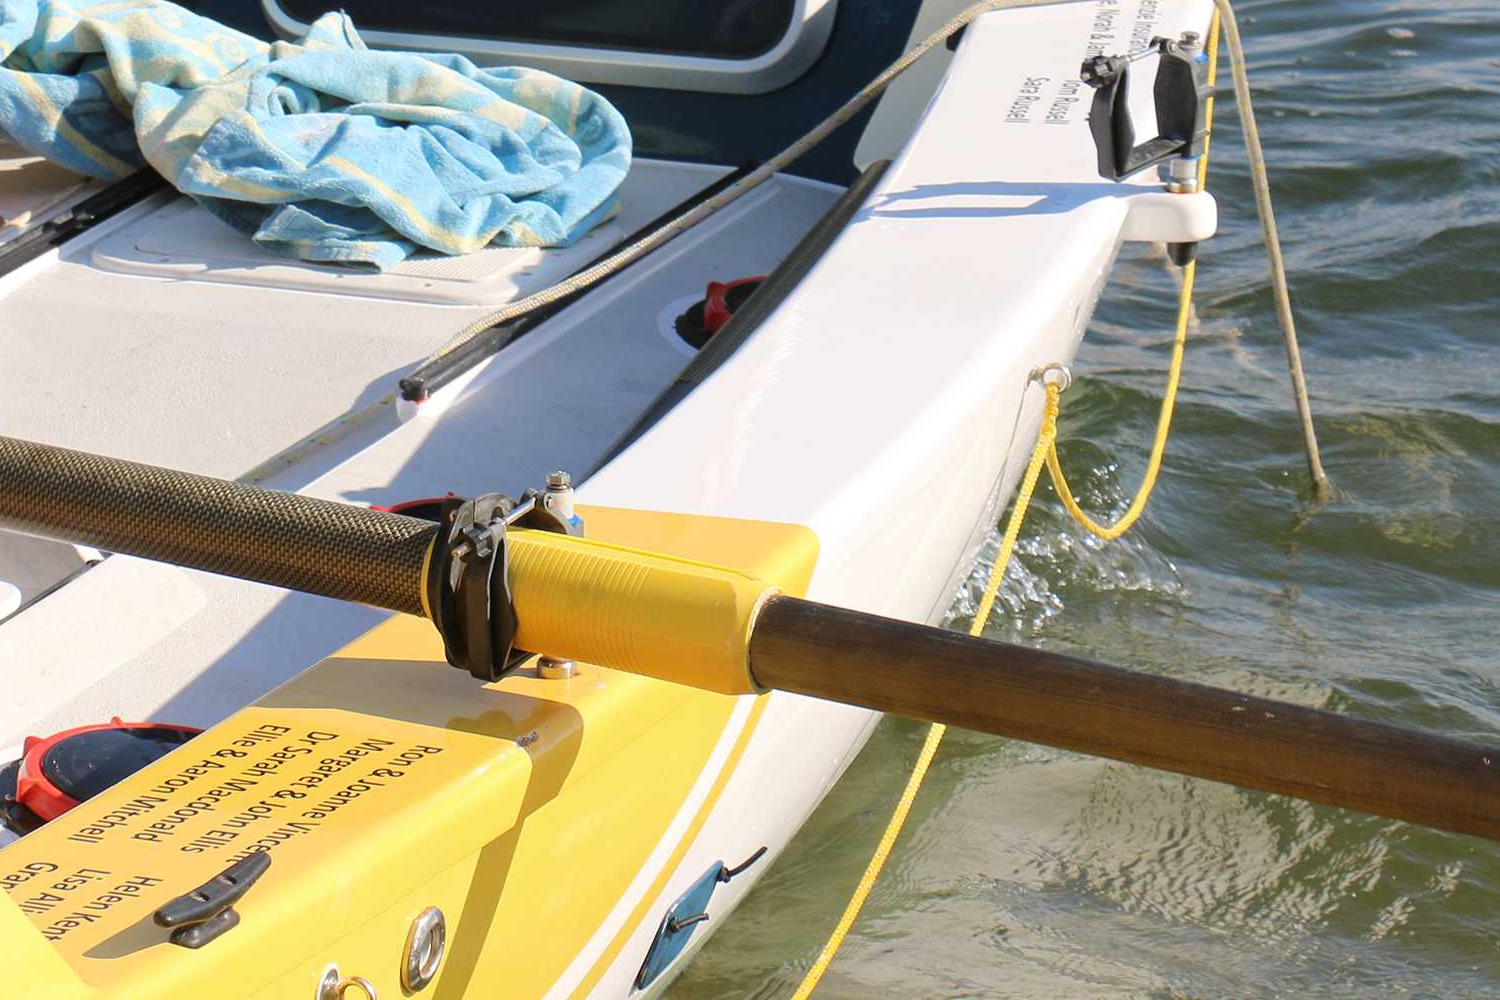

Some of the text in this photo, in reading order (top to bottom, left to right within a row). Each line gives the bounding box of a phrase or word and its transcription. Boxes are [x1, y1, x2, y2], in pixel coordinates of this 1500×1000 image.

[1085, 42, 1110, 61] Jam
[1004, 77, 1051, 123] Sara Russell
[1043, 97, 1080, 125] Russell
[367, 767, 405, 778] &
[388, 745, 444, 767] Ron
[67, 724, 292, 843] Ellie & Aaron Mitchell
[131, 731, 339, 842] Dr Sarah Macdonald
[180, 738, 395, 853] Margaret & John Ellis
[301, 779, 386, 819] Joanne
[0, 862, 59, 894] Gran
[18, 868, 112, 916] Lisa Alli
[83, 875, 164, 910] Helen
